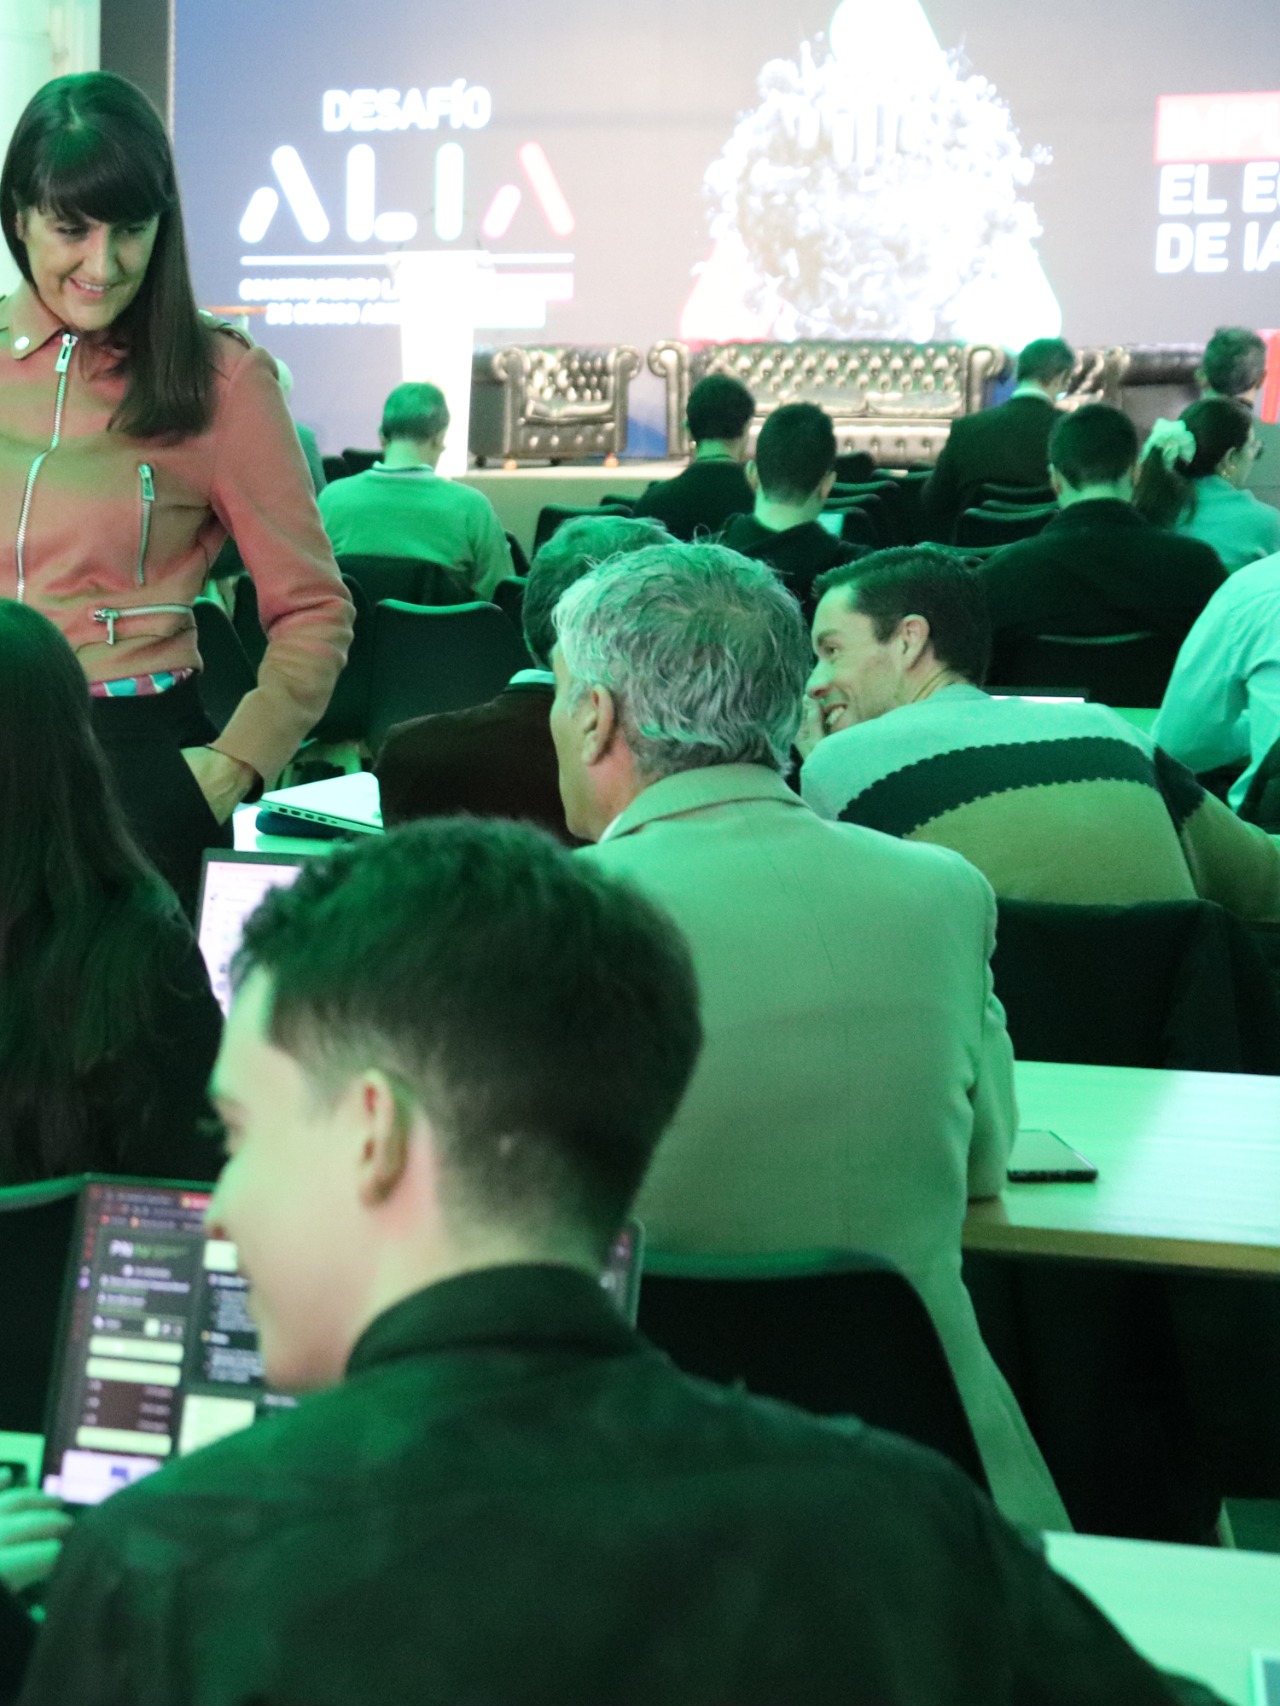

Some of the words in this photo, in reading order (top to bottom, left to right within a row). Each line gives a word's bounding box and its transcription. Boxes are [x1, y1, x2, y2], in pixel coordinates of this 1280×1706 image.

[322, 79, 491, 132] DESAFÍO
[238, 141, 575, 244] ALIA
[1158, 163, 1228, 215] EL
[1155, 221, 1231, 274] DE
